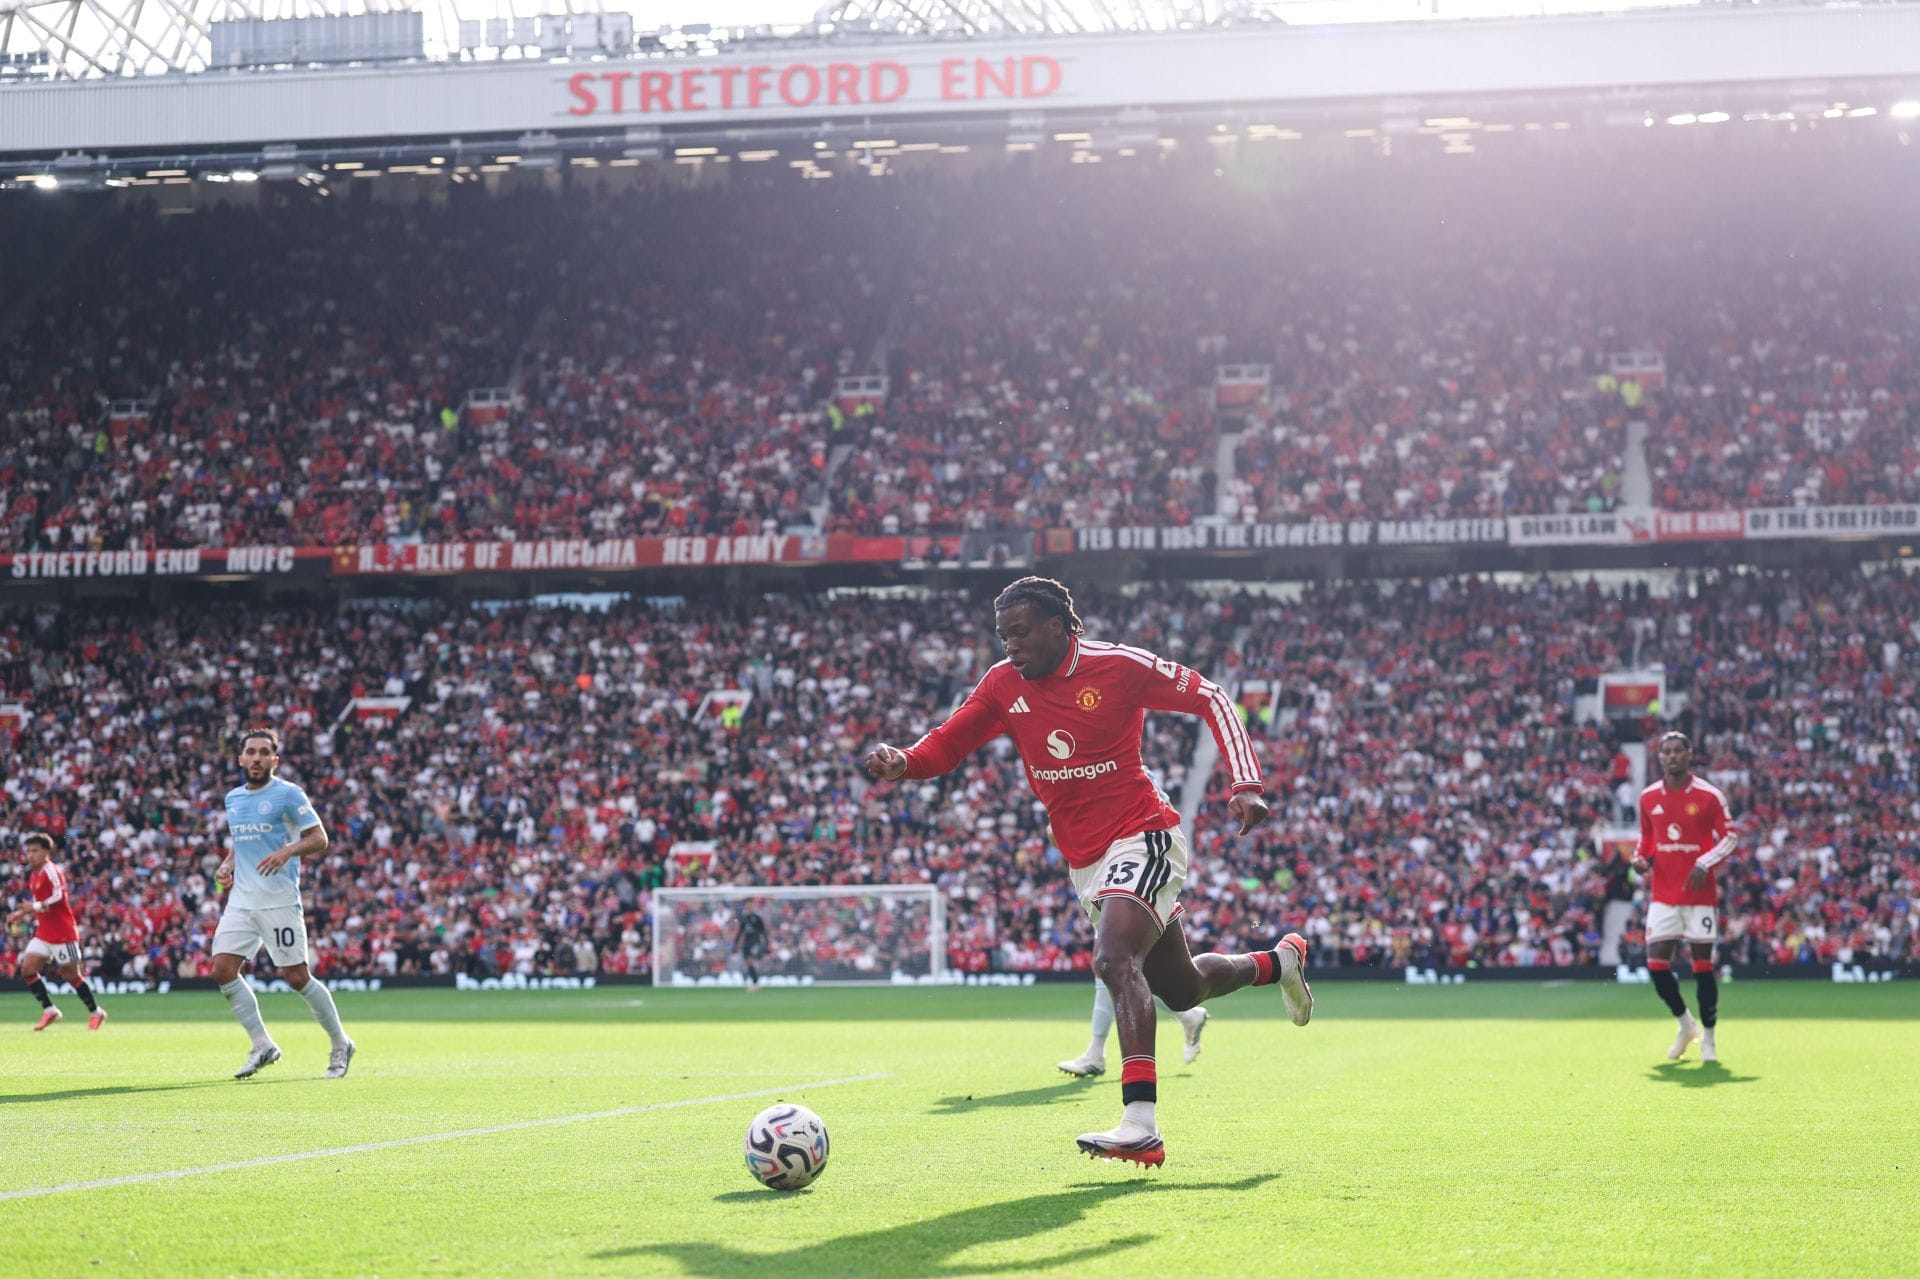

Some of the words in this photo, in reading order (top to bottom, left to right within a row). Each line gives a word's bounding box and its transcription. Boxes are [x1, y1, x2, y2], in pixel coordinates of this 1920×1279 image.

[567, 62, 910, 117] STRETFORD
[939, 55, 1063, 101] END
[1521, 518, 1573, 536] DENIS
[1578, 517, 1617, 534] LAW
[1814, 510, 1917, 528] STRETFORD
[1254, 522, 1343, 547] FLOWERS
[1378, 518, 1506, 544] MANCHESTER
[11, 551, 148, 578] STRETFORD
[154, 549, 200, 574] END
[226, 546, 295, 573] MUFC
[1029, 760, 1118, 784] Snapdragon
[1104, 861, 1140, 888] 13
[273, 927, 295, 948] 10
[1702, 917, 1712, 934] 9
